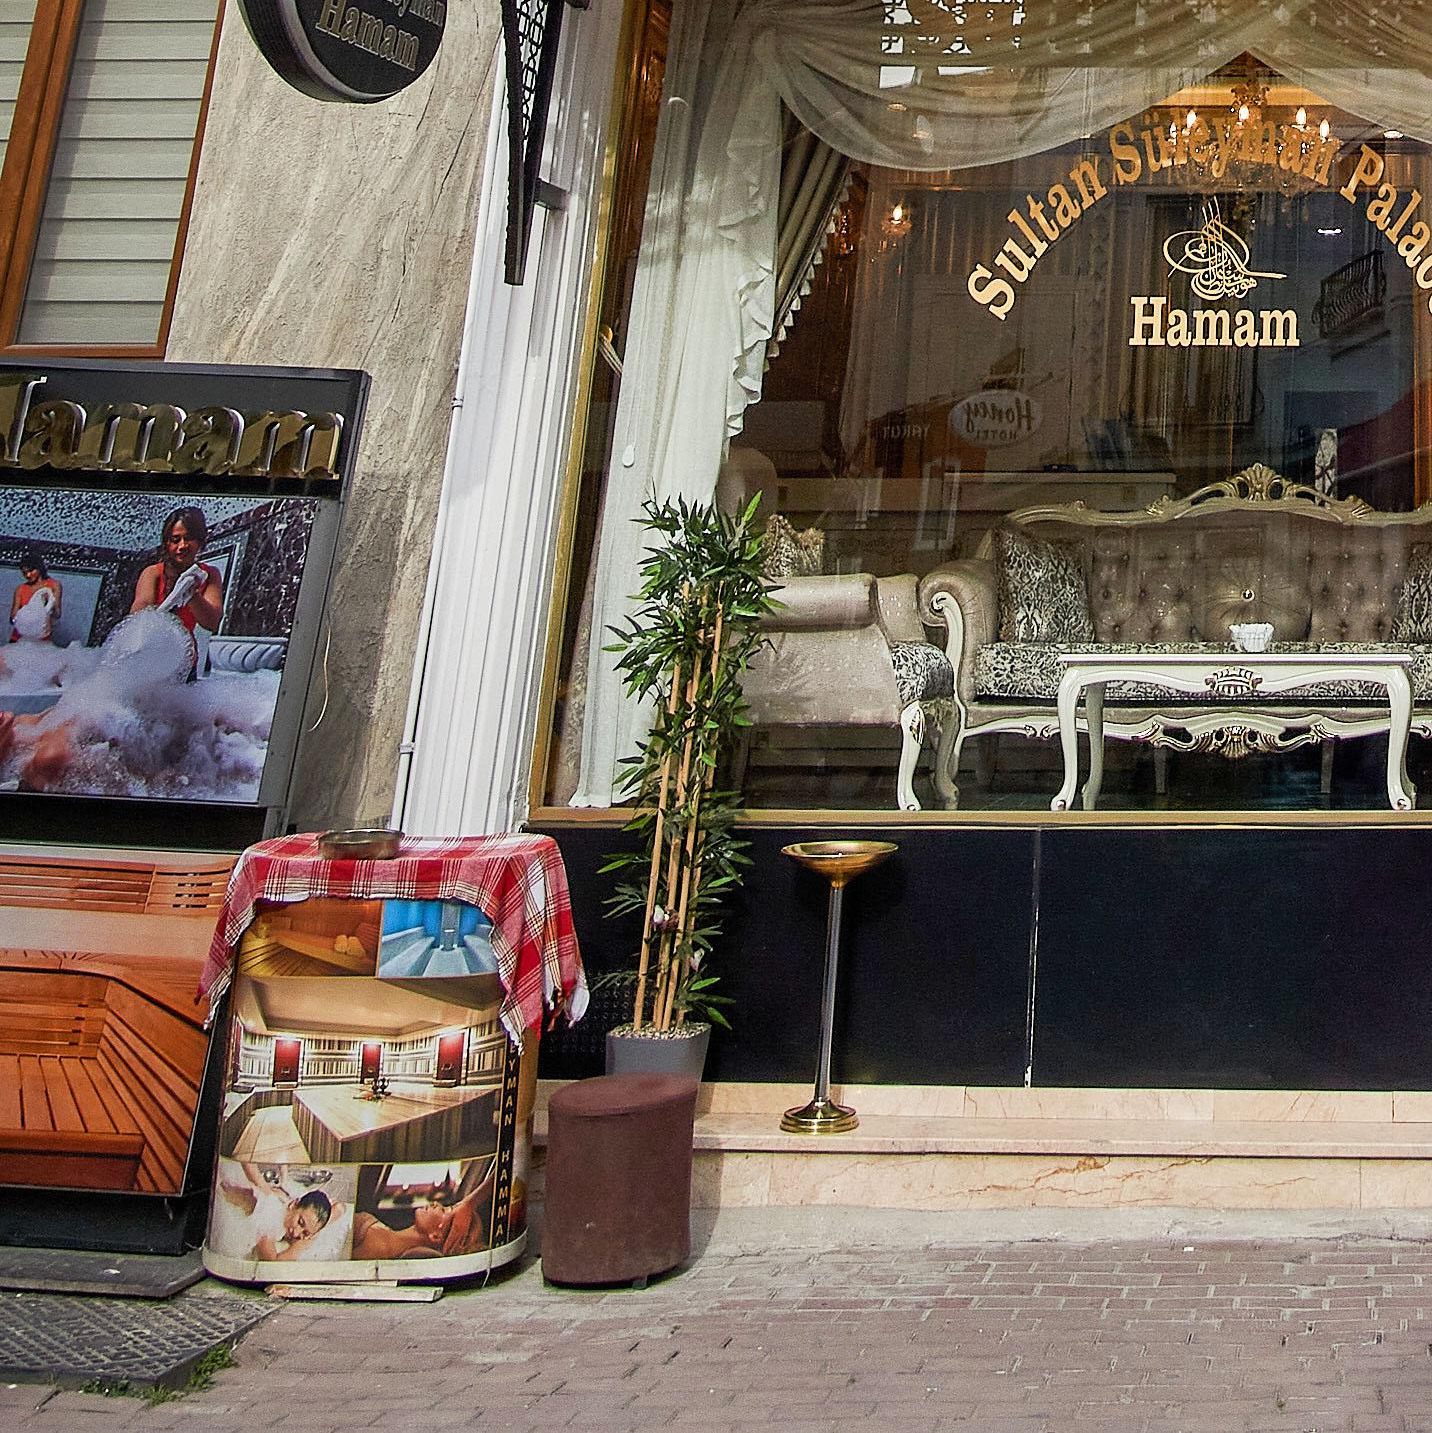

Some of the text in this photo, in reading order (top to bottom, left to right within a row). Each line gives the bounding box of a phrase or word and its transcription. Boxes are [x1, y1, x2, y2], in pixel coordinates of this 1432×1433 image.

[967, 155, 1110, 322] Sultan
[1109, 105, 1342, 187] Süleyman
[1128, 296, 1301, 348] Hamam
